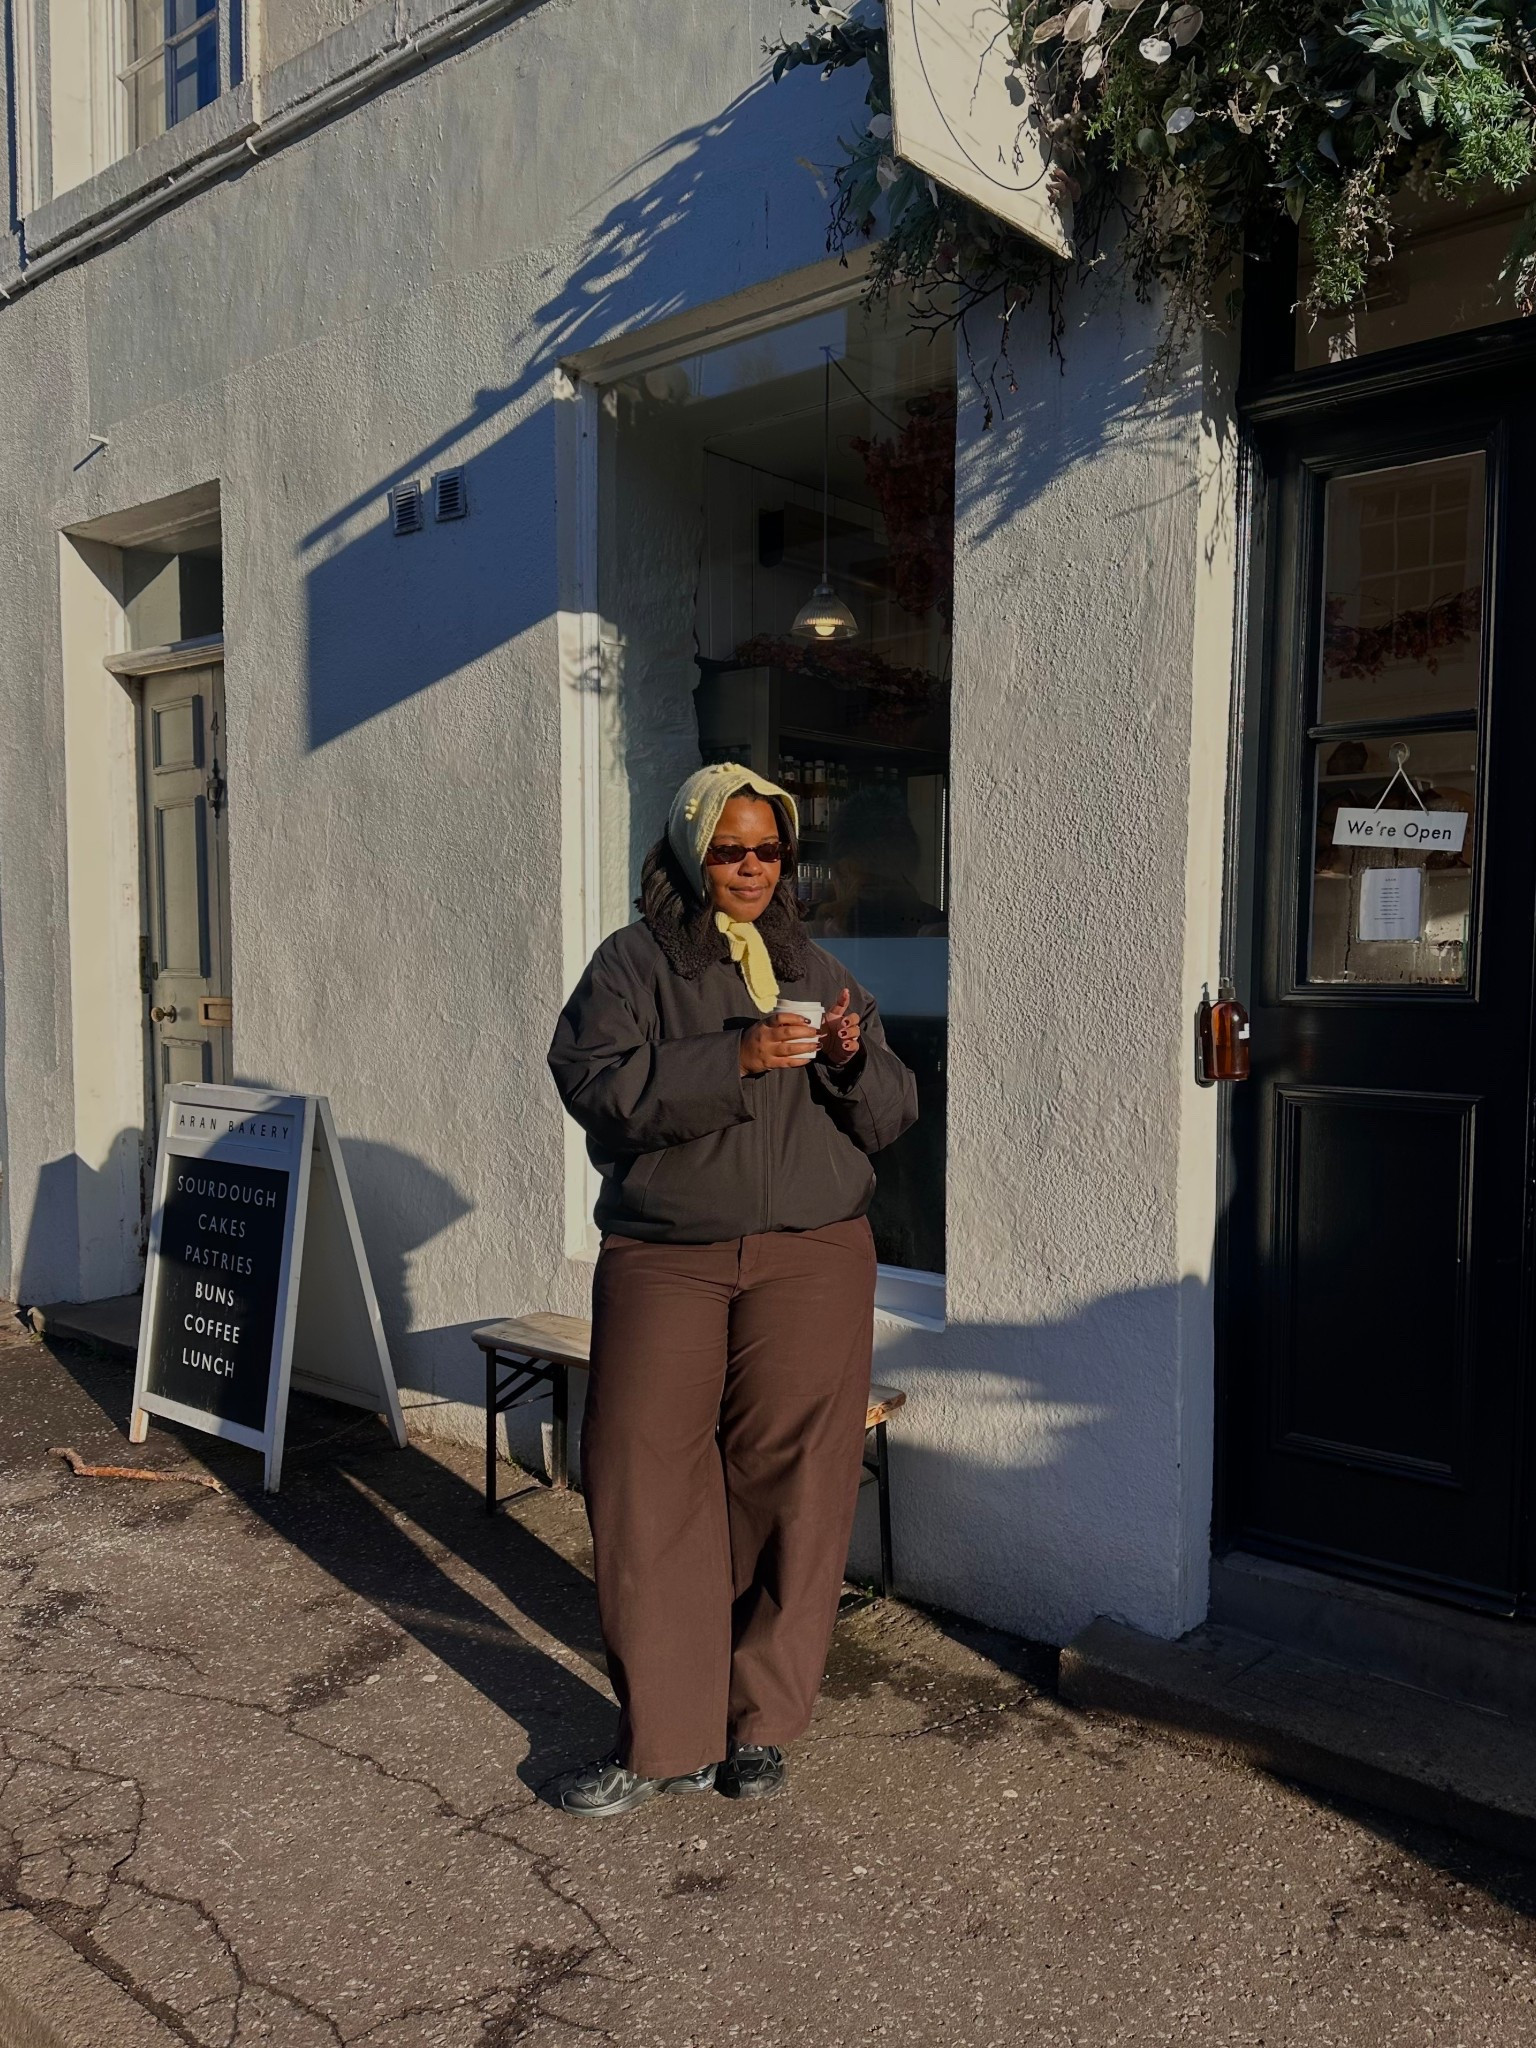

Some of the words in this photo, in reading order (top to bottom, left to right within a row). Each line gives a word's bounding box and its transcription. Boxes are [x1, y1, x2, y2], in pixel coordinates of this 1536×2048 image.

[1347, 820, 1396, 837] We're
[1403, 823, 1452, 843] Open
[179, 1114, 217, 1130] ARAN
[228, 1120, 289, 1140] BAKERY
[177, 1175, 276, 1208] SOURDOUGH
[198, 1213, 246, 1238] CAKES
[185, 1244, 253, 1275] PASTRIES
[195, 1281, 234, 1307] BUNS
[184, 1313, 240, 1344] COFFEE
[182, 1347, 235, 1378] LUNCH
